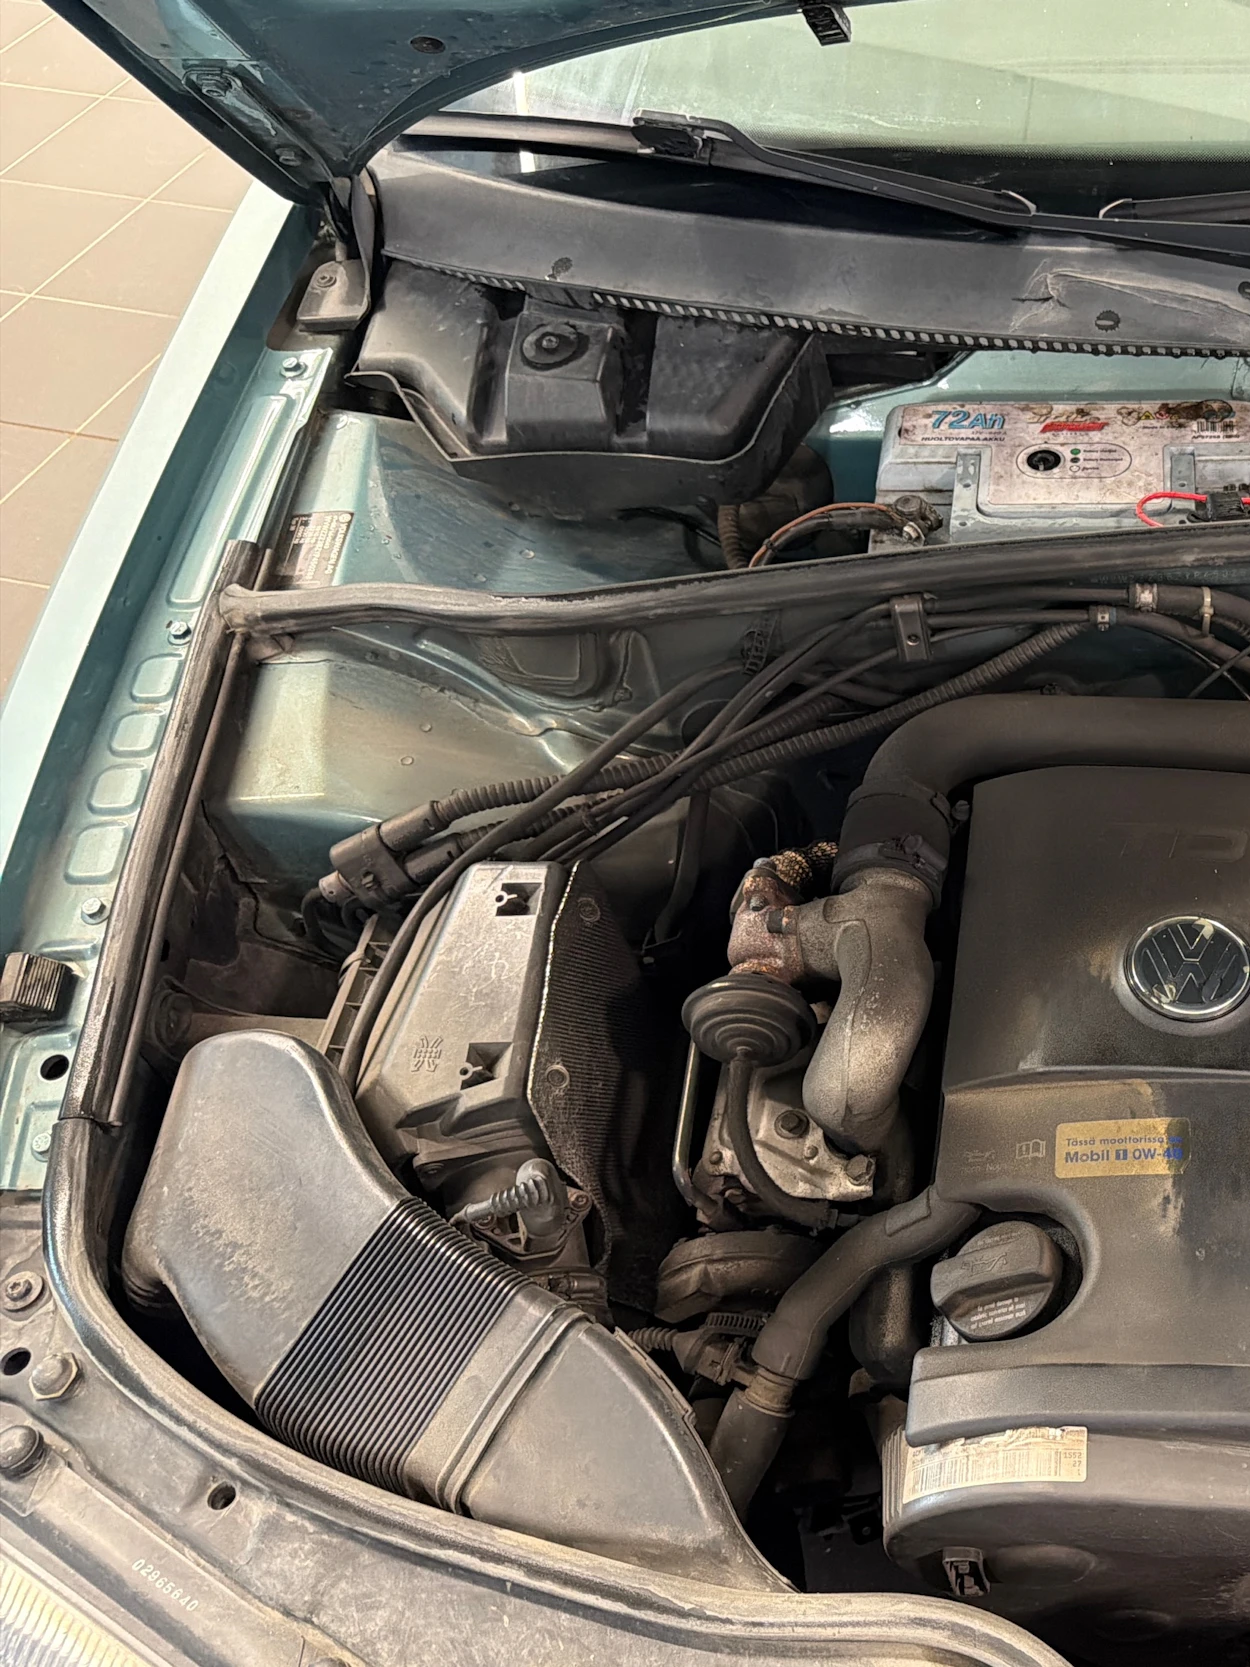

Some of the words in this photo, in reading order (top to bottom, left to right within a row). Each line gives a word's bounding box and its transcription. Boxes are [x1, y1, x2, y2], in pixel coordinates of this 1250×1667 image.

[931, 409, 1006, 430] 72Ah
[1066, 1138, 1095, 1148] Tässä
[1064, 1149, 1109, 1163] Mobil
[132, 1558, 200, 1612] 02965640
